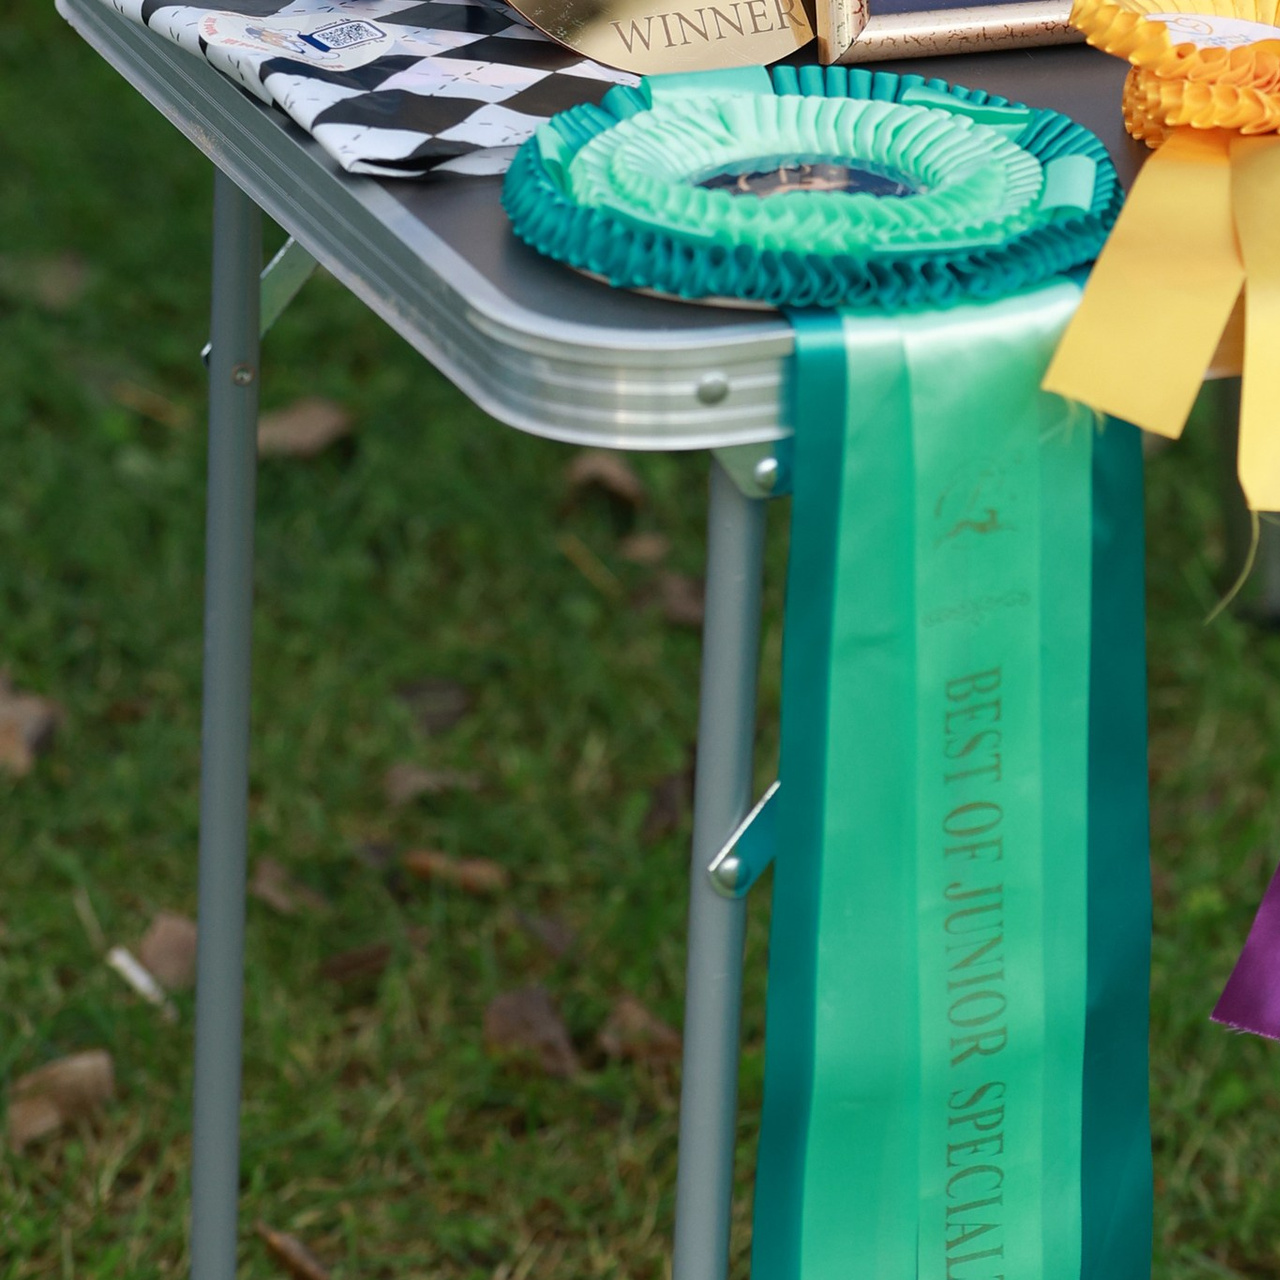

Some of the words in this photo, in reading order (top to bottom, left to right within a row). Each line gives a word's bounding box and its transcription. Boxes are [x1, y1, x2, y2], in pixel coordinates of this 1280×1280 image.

[943, 666, 1003, 786] BEST
[943, 801, 1004, 863] OF
[943, 882, 1008, 1067] JUNIOR
[945, 1081, 1006, 1280] SPECIAL
